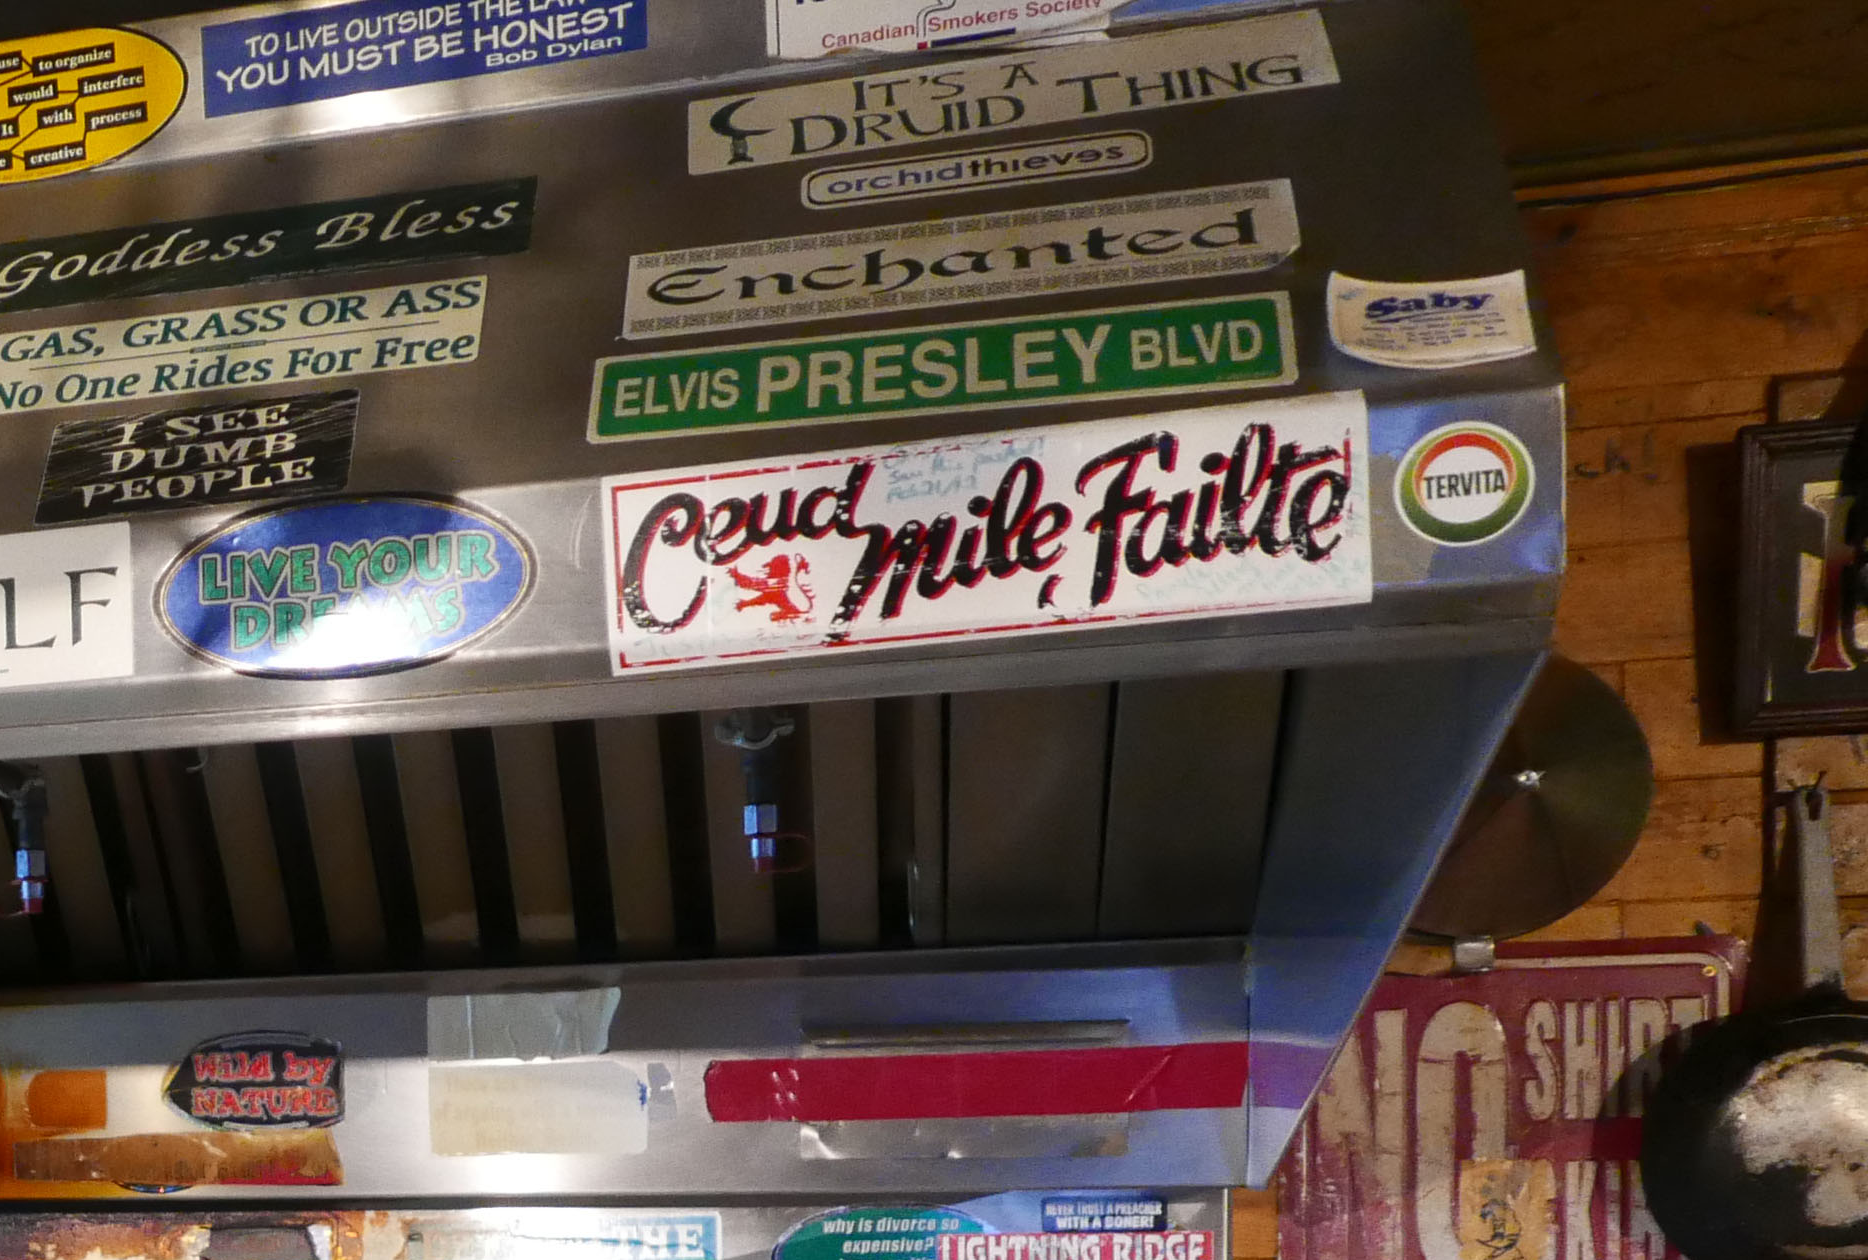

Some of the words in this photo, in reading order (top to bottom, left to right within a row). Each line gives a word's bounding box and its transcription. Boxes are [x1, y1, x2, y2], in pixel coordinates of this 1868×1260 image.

[217, 63, 289, 94] YOU
[300, 45, 400, 80] MUST
[413, 35, 465, 60] BE
[474, 2, 632, 53] HONEST
[246, 33, 279, 58] TO
[286, 24, 338, 52] LIVE
[345, 4, 463, 42] OUTSIDE
[486, 47, 537, 68] Bob
[546, 35, 623, 59] Dylan
[822, 21, 916, 49] Canadian
[928, 5, 1018, 33] Smokers
[55, 50, 112, 70] organize
[13, 86, 54, 102] would
[84, 74, 143, 94] interfere
[790, 95, 1025, 154] DRUID
[1057, 55, 1303, 114] THING
[43, 109, 73, 124] with
[90, 108, 142, 128] process
[30, 146, 83, 165] creative
[827, 144, 1124, 195] orchidthieves
[316, 198, 521, 250] Bless
[647, 208, 1260, 305] Enchanted
[0, 328, 105, 363] GAS,
[123, 304, 288, 348] GRASS
[299, 293, 367, 326] OR
[384, 280, 482, 317] ASS
[55, 370, 138, 403] One
[149, 353, 271, 392] Rides
[285, 348, 361, 378] For
[371, 332, 476, 369] Free
[614, 366, 739, 418] ELVIS
[756, 325, 1110, 413] PRESLEY
[1131, 318, 1262, 370] BLVD
[166, 403, 291, 440] SEE
[110, 432, 297, 474] DUMB
[81, 458, 315, 507] PEOPLE
[1424, 468, 1507, 503] TERVITA
[200, 548, 317, 602] LIVE
[328, 533, 496, 589] YOUR
[624, 461, 872, 633] Ceud
